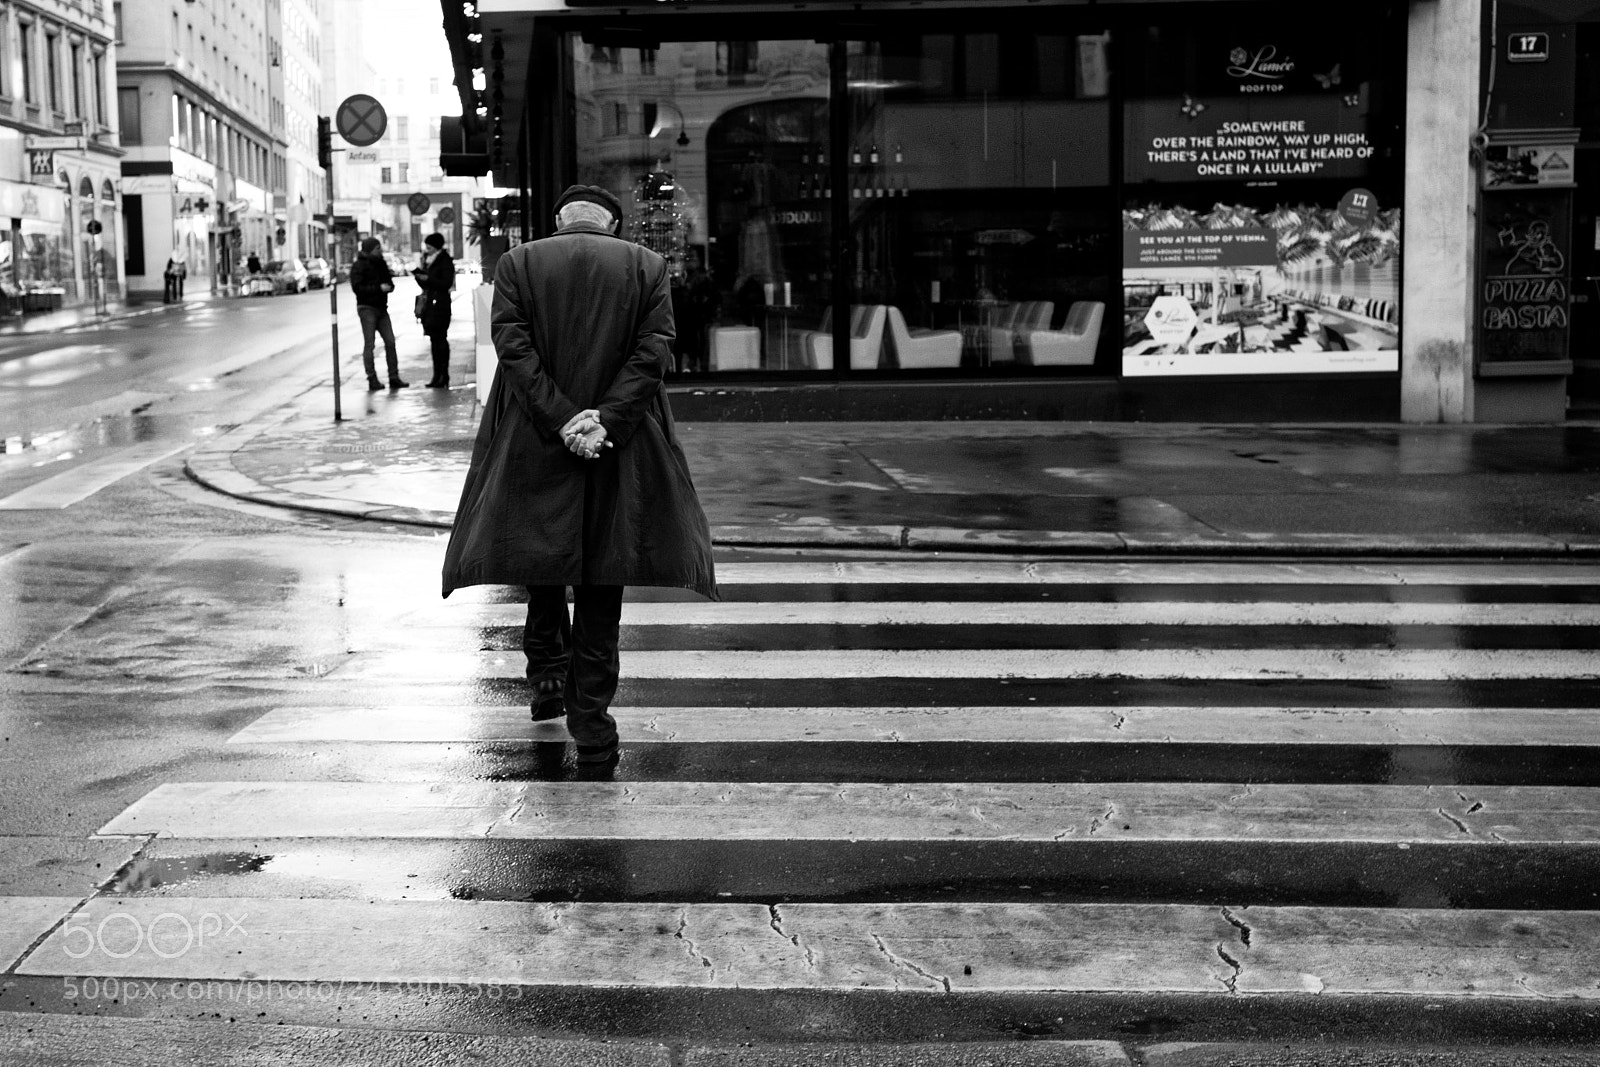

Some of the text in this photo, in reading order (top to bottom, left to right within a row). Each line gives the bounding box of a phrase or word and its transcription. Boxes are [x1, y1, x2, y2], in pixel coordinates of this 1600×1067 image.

[1520, 36, 1537, 52] 17
[1239, 84, 1285, 93] ROOFTOP
[1152, 132, 1369, 149] OVER THE RAINBOW, WAY UP HIGH,
[348, 151, 377, 162] Anfang
[1147, 146, 1375, 162] THERE'S A LAND THAT I'VE HEARD OF
[1197, 163, 1233, 175] ONCE
[1236, 163, 1250, 174] IN
[1252, 163, 1262, 174] A
[1140, 236, 1155, 244] SEE
[1157, 236, 1174, 244] YOU
[1175, 236, 1185, 244] AT
[1204, 235, 1220, 243] TOP
[1222, 235, 1234, 243] OF
[1484, 279, 1566, 303] PIZZA
[1483, 305, 1567, 329] PASTA
